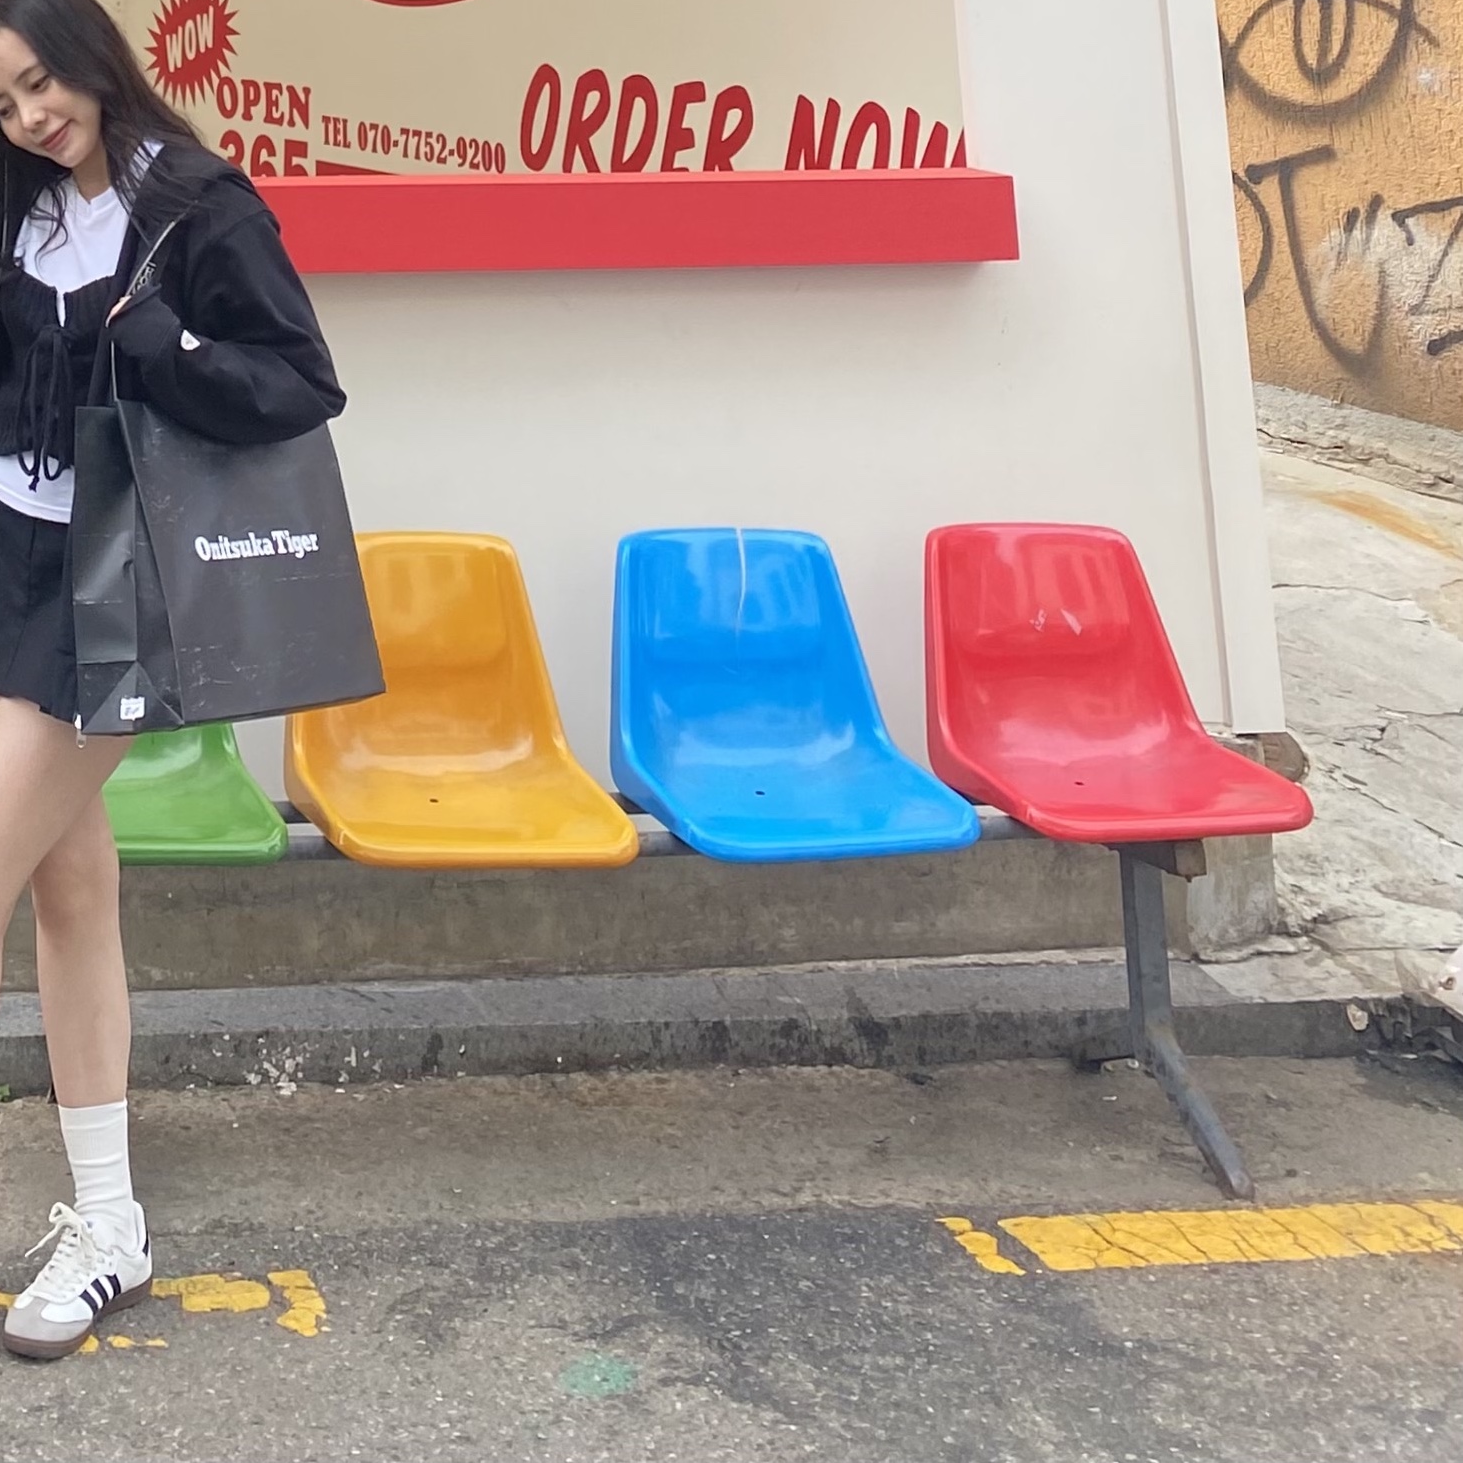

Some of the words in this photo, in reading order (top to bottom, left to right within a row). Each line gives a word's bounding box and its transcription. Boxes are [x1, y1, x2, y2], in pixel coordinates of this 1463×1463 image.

[165, 4, 215, 73] WOW
[215, 76, 312, 131] OPEN
[520, 63, 754, 174] ORDER
[218, 128, 309, 177] 365
[321, 114, 351, 149] TEL
[357, 120, 507, 175] 070-7752-9200
[195, 532, 275, 561] Onitsuka
[271, 530, 319, 559] Tiger
